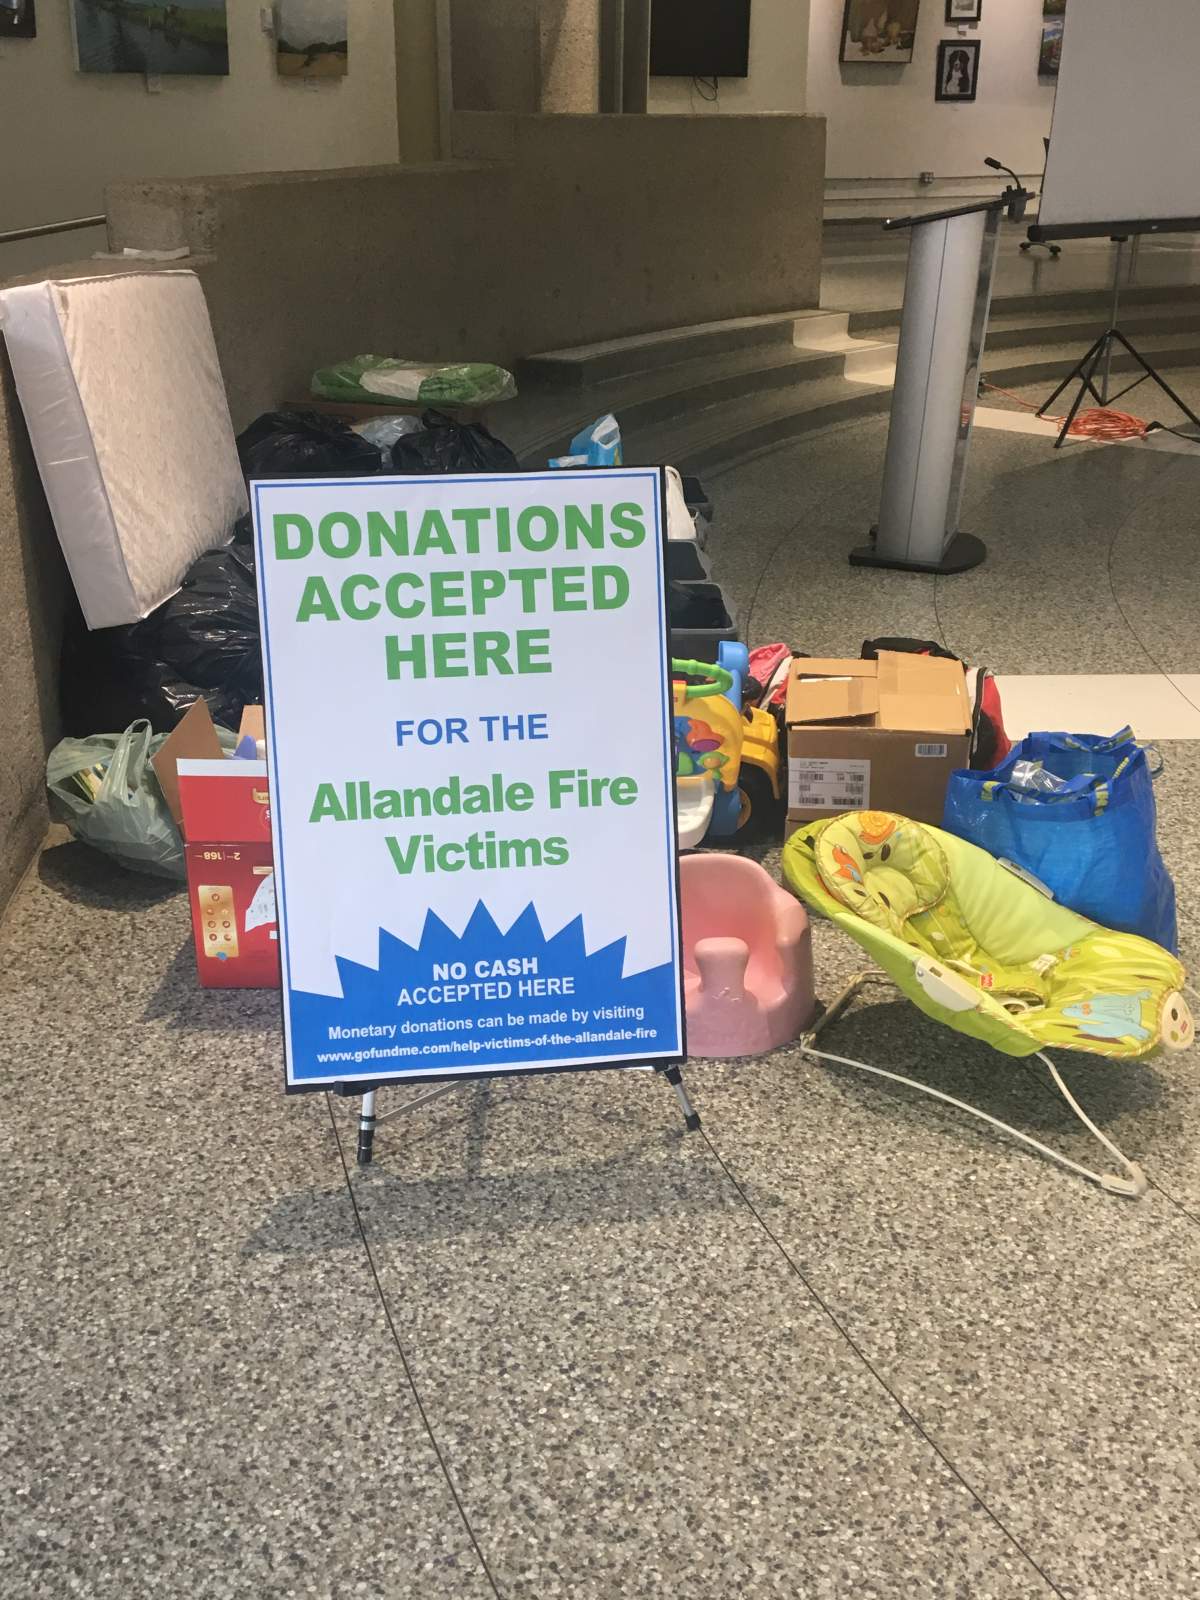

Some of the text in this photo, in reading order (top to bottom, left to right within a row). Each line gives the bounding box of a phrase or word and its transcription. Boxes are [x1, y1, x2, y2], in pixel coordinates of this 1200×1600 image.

[272, 503, 646, 560] DONATIONS
[297, 566, 630, 622] ACCEPTED
[386, 629, 552, 680] HERE
[395, 713, 550, 748] FOR THE
[309, 769, 638, 822] Allandale Fire
[203, 851, 222, 860] 168
[386, 832, 569, 875] Victims
[432, 957, 539, 981] NO CASH
[397, 977, 575, 1006] ACCEPTED HERE
[328, 1005, 645, 1040] Monetary donations can be made by visiting
[317, 1028, 658, 1063] www.gofundme.com/help-victims-of-the-allandale-fire
